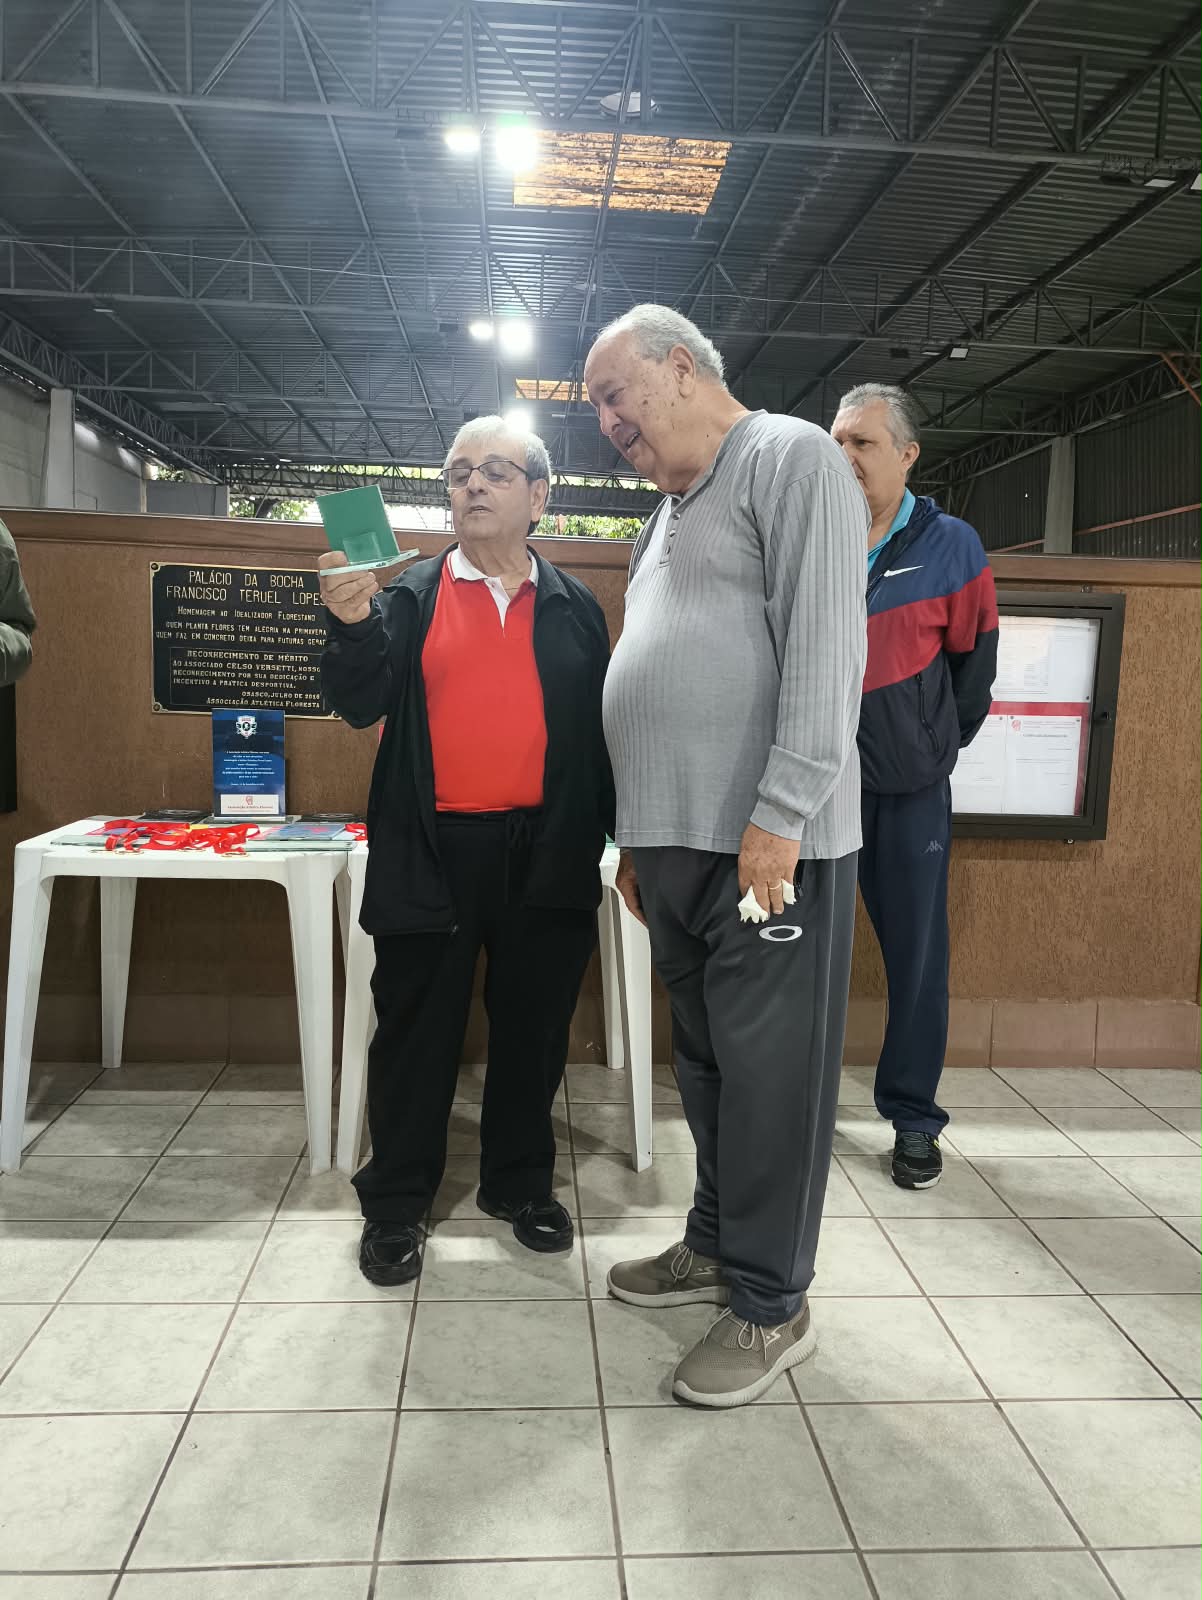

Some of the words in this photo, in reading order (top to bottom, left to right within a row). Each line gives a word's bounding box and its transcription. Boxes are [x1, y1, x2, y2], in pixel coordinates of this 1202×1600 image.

[189, 570, 232, 585] PALÁCIO
[244, 573, 258, 587] DA
[270, 574, 304, 588] BOCHA
[166, 585, 227, 601] FRANCISCO
[239, 589, 282, 604] TERUEL
[166, 621, 183, 629] QUEM
[211, 623, 235, 631] FLORES
[255, 625, 279, 633] ALEGRIA
[294, 627, 327, 636] PRIMAVERA
[176, 632, 187, 640] FAZ
[203, 633, 235, 642] CONCRETO
[260, 636, 275, 644] PARA
[278, 637, 304, 645] FUTURAS
[187, 650, 260, 661] RECONHECIMENTO
[263, 653, 274, 661] DE
[278, 653, 309, 662] MÉRITO
[226, 662, 253, 670] CELSO
[173, 669, 236, 678] RECONHECIMENTO
[269, 673, 308, 681] DEDICAÇÃO
[173, 678, 210, 686] INCENTIVO
